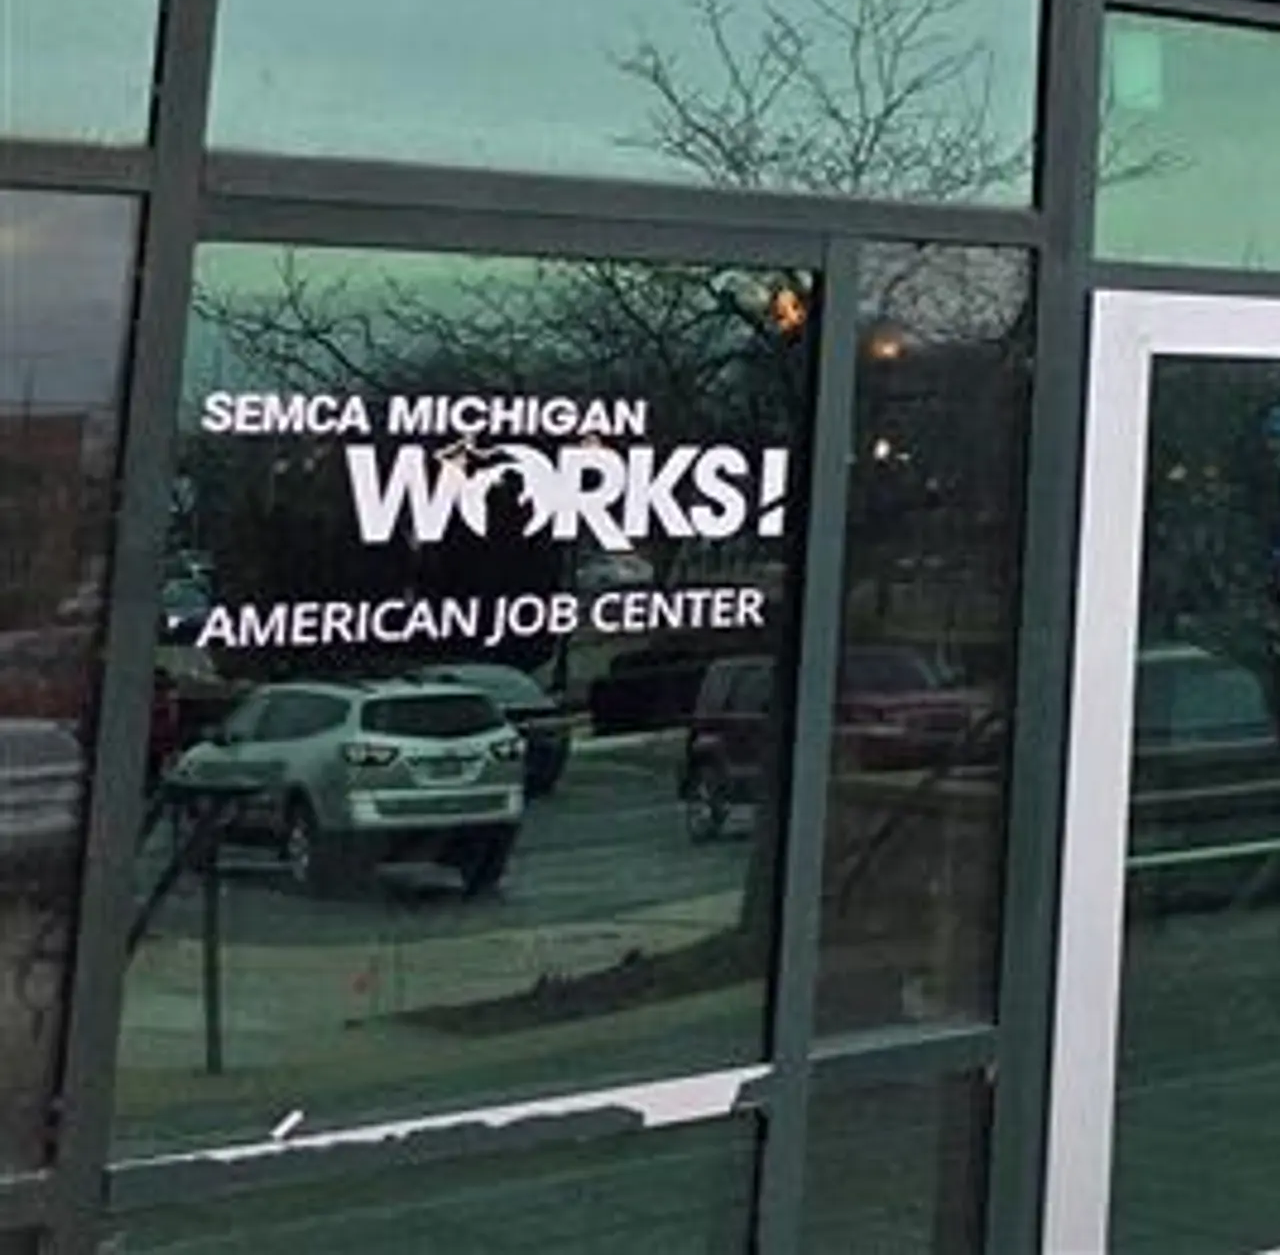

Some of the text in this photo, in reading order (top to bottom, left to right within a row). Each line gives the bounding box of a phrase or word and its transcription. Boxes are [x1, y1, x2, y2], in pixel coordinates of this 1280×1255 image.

[202, 391, 648, 436] SEMCA MICHIGAN
[345, 443, 790, 551] WORKS!
[198, 588, 765, 647] AMERICAN JOB CENTER
